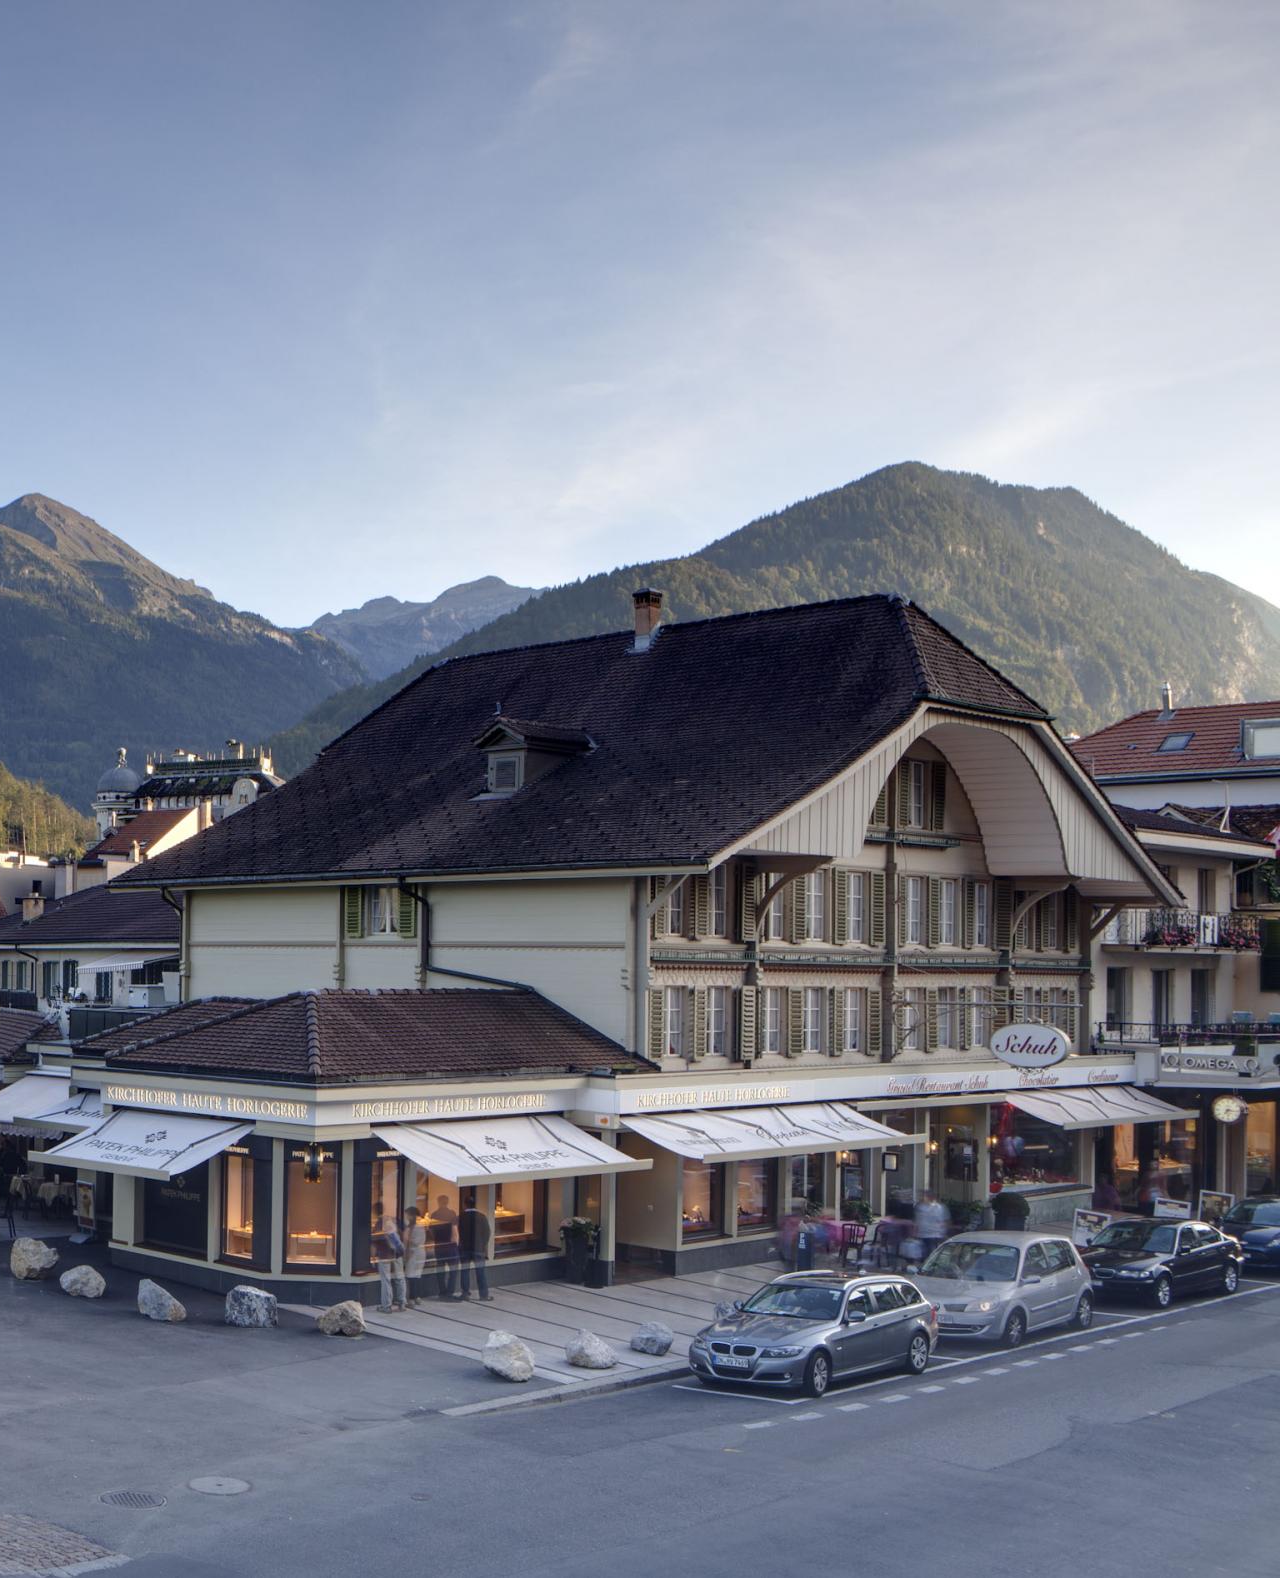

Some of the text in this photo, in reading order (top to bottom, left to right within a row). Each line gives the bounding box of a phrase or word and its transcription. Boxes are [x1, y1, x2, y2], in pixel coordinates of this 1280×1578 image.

[995, 1034, 1058, 1055] Schuh
[1184, 1057, 1239, 1071] OMEGA
[918, 1075, 963, 1091] Restaurant
[107, 1086, 308, 1120] KIRCHHOFER HAUTE HORLOGERIE
[352, 1094, 546, 1117] KIRCHHOFER HAUTE HORLOGERIE
[637, 1085, 791, 1108] KIRCHHOFER HAUTE HORLOGERIE
[85, 1138, 123, 1151] PATEK
[510, 1149, 569, 1164] PHILIPPE
